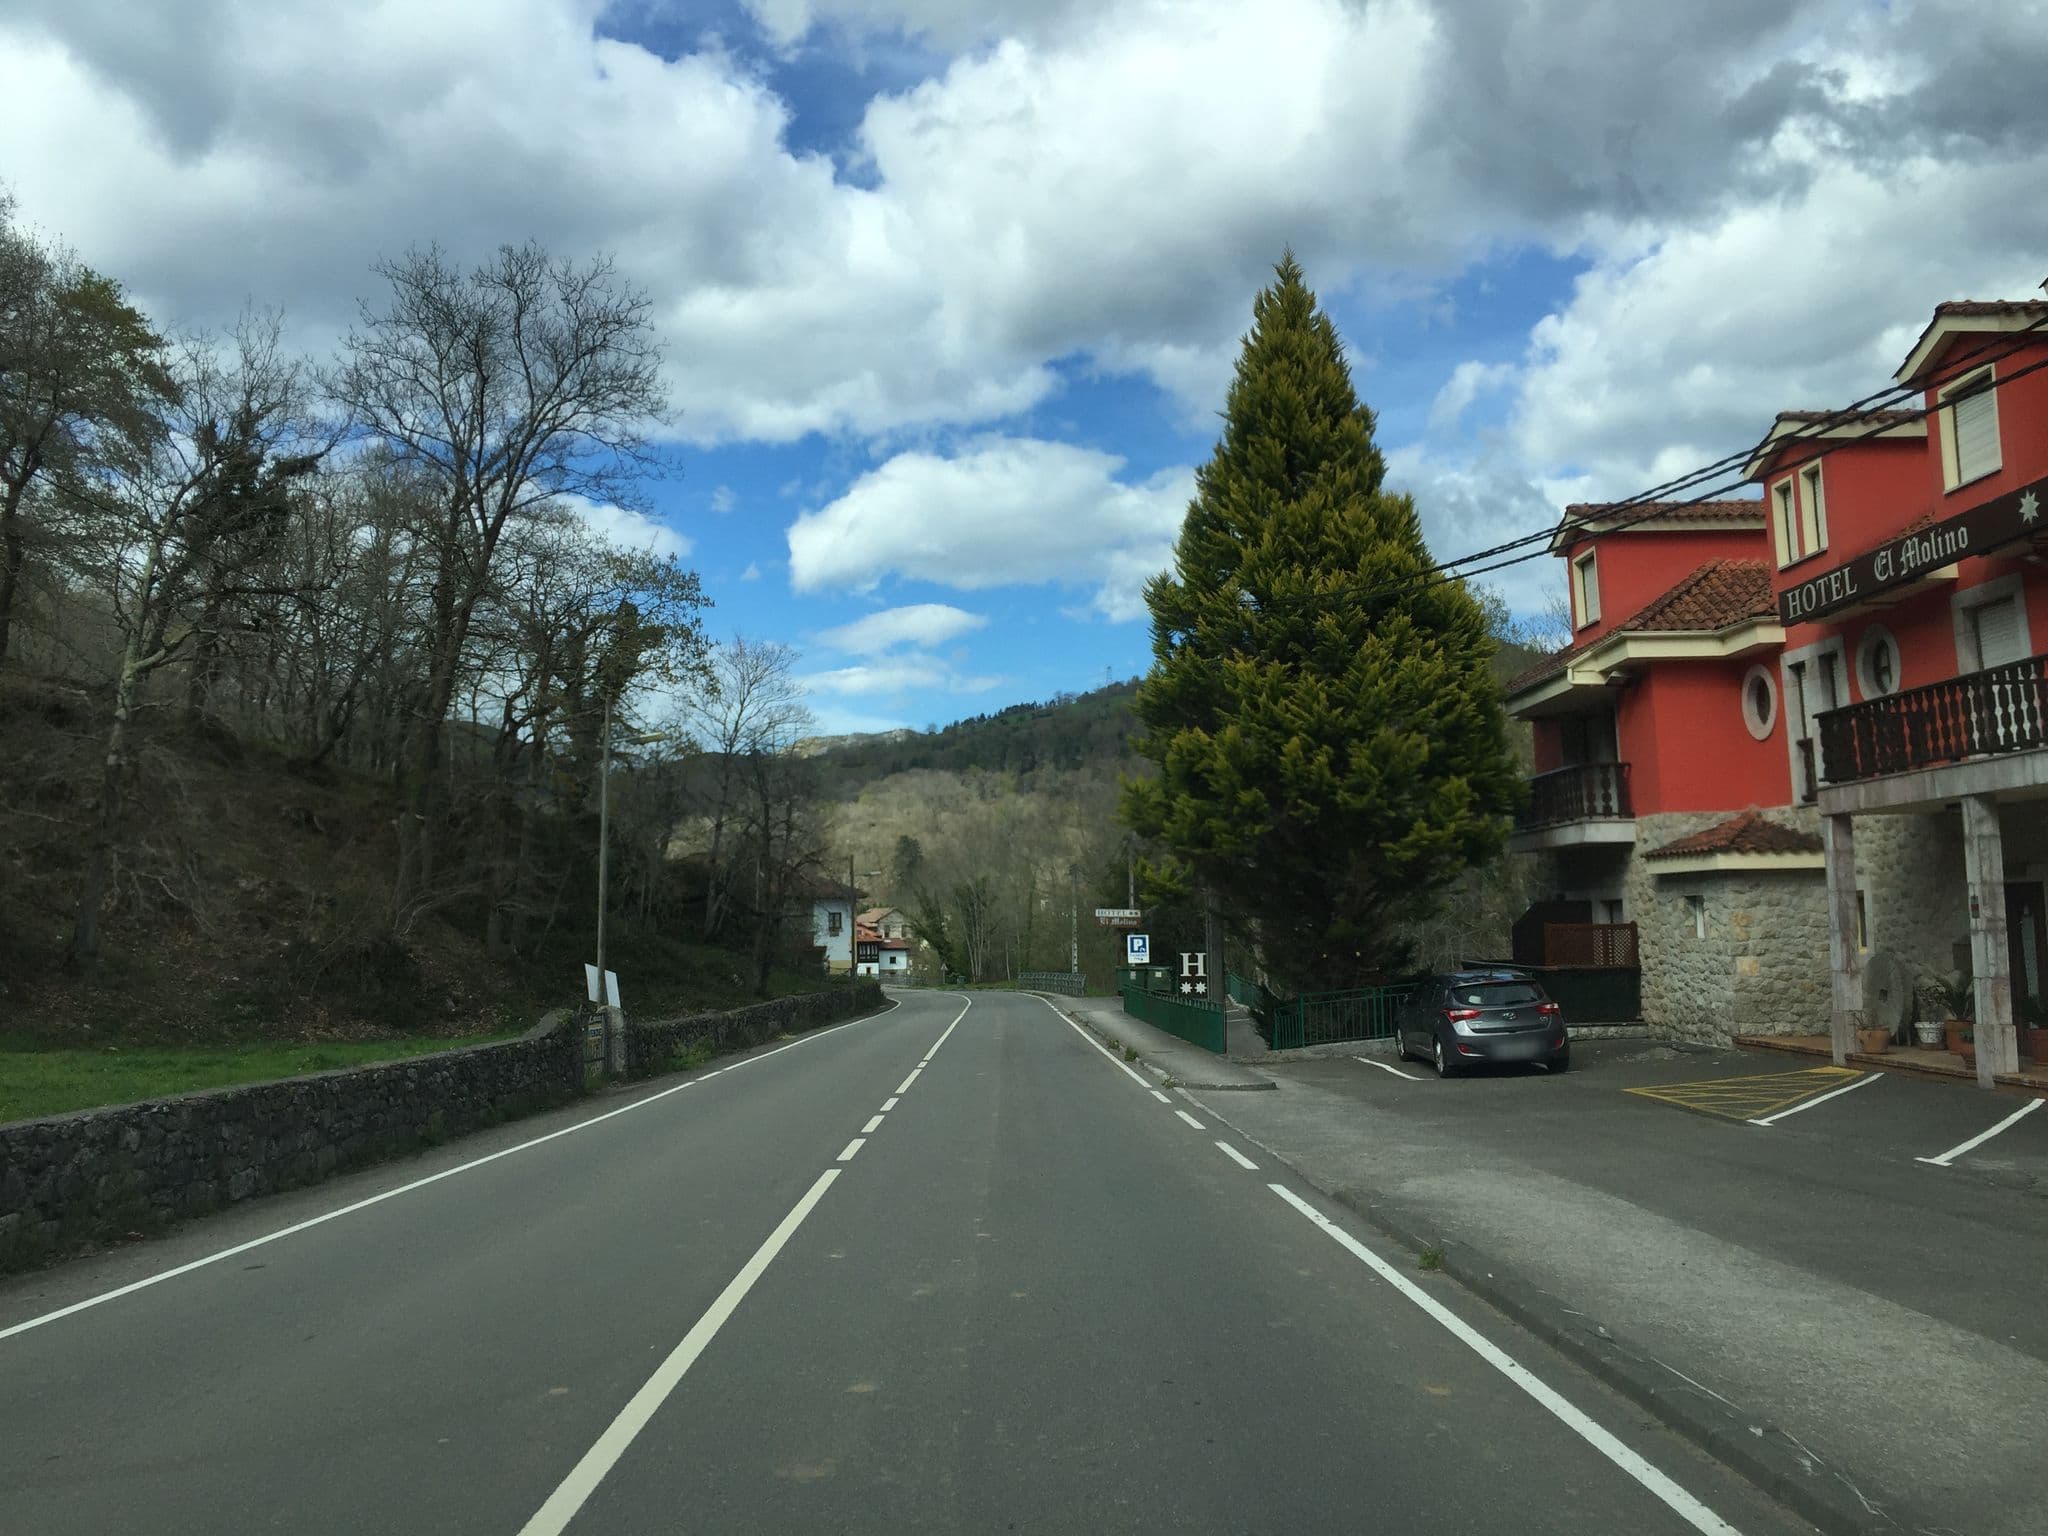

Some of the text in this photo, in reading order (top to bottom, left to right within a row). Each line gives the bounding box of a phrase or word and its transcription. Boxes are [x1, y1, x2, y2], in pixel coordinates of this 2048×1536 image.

[1786, 525, 1969, 620] HOTEL El Molino
[1133, 938, 1144, 952] P
[1180, 952, 1207, 977] H
